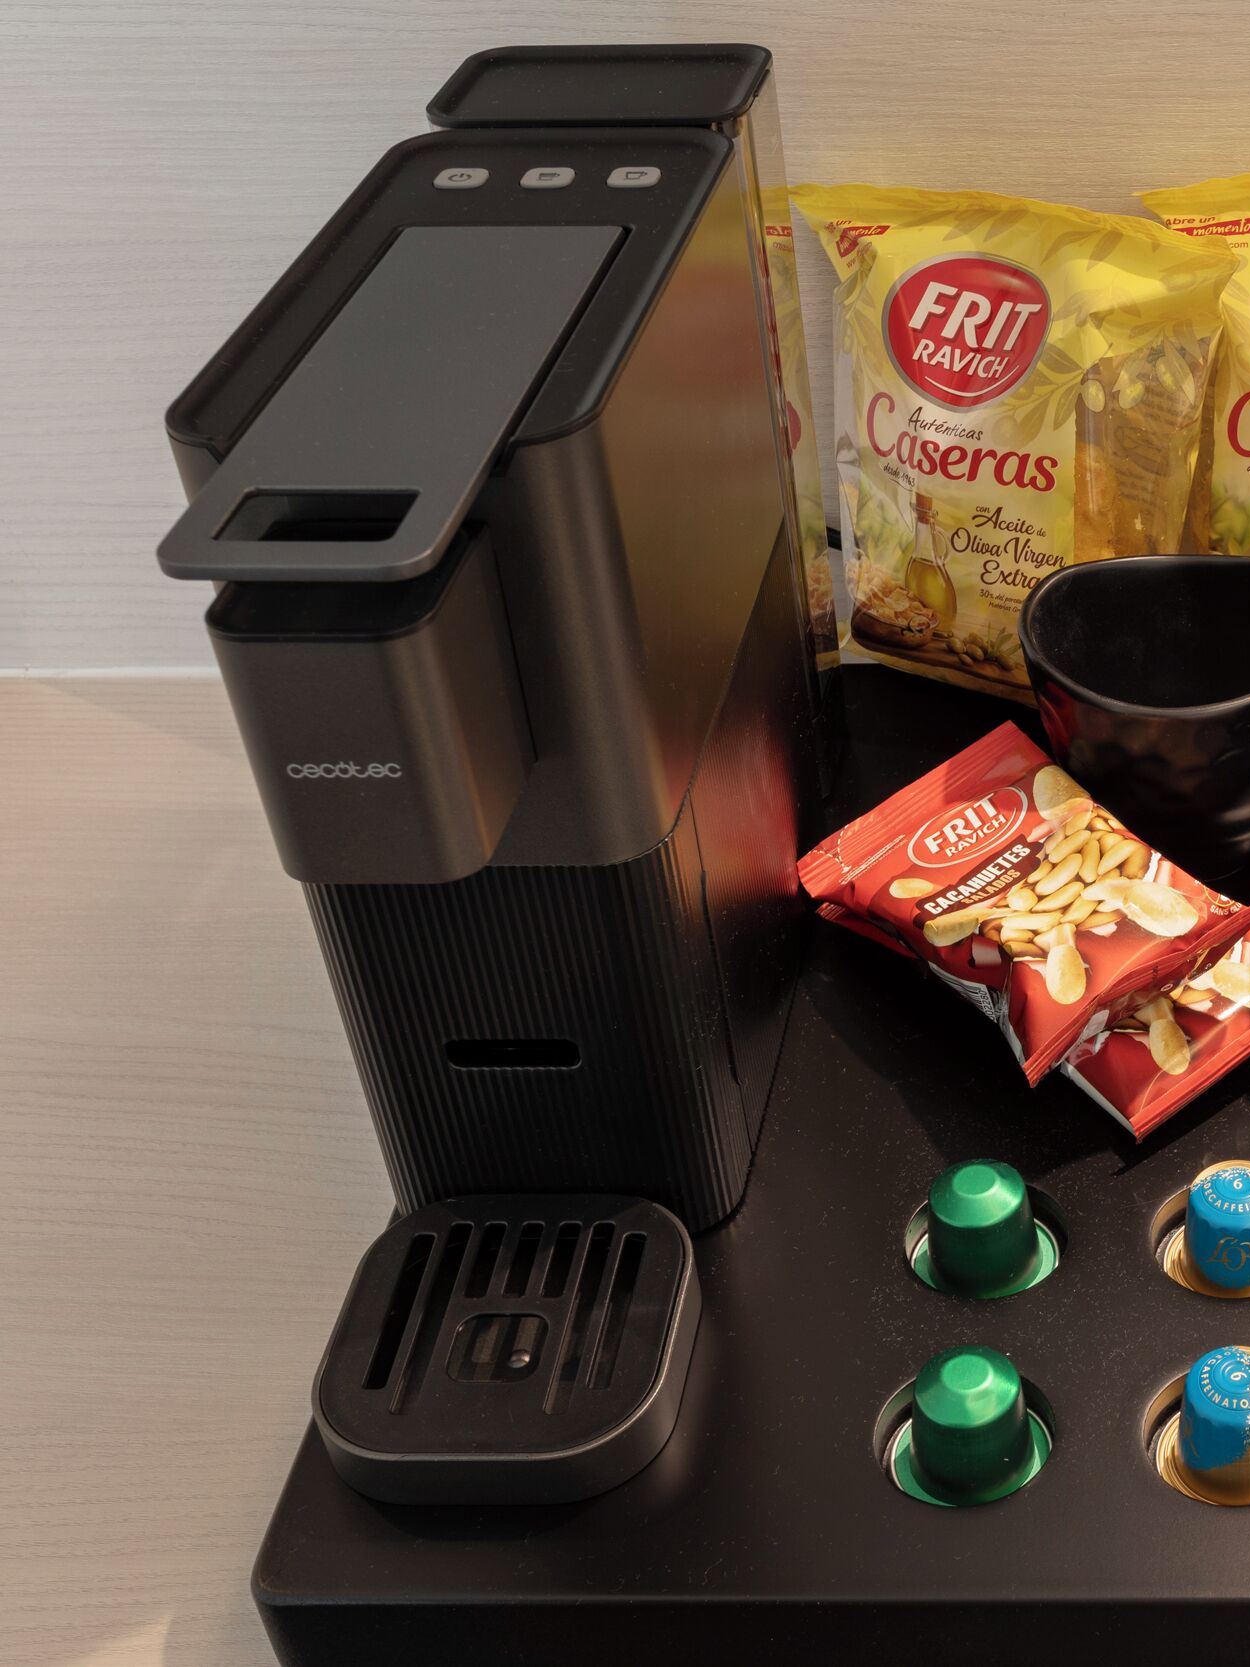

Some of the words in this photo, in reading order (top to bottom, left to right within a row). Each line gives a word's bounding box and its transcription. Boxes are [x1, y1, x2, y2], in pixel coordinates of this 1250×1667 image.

[1166, 217, 1196, 226] Abre
[1199, 216, 1216, 224] un
[908, 281, 1042, 351] FRIT
[912, 337, 1009, 380] RAVICH
[908, 406, 984, 441] Auténticas
[866, 391, 1059, 492] Caseras
[972, 506, 1035, 536] Aceite
[975, 505, 992, 514] con
[950, 527, 1002, 558] Oliva
[1003, 536, 1067, 569] Virgen
[1036, 527, 1047, 538] de
[286, 761, 402, 779] cecotec
[923, 792, 998, 855] FRIT
[944, 814, 1007, 857] RAVICH
[923, 844, 1031, 915] CACAHUETES
[960, 868, 1022, 904] SALADOS
[1210, 904, 1229, 916] SANS
[1232, 1178, 1243, 1190] 6
